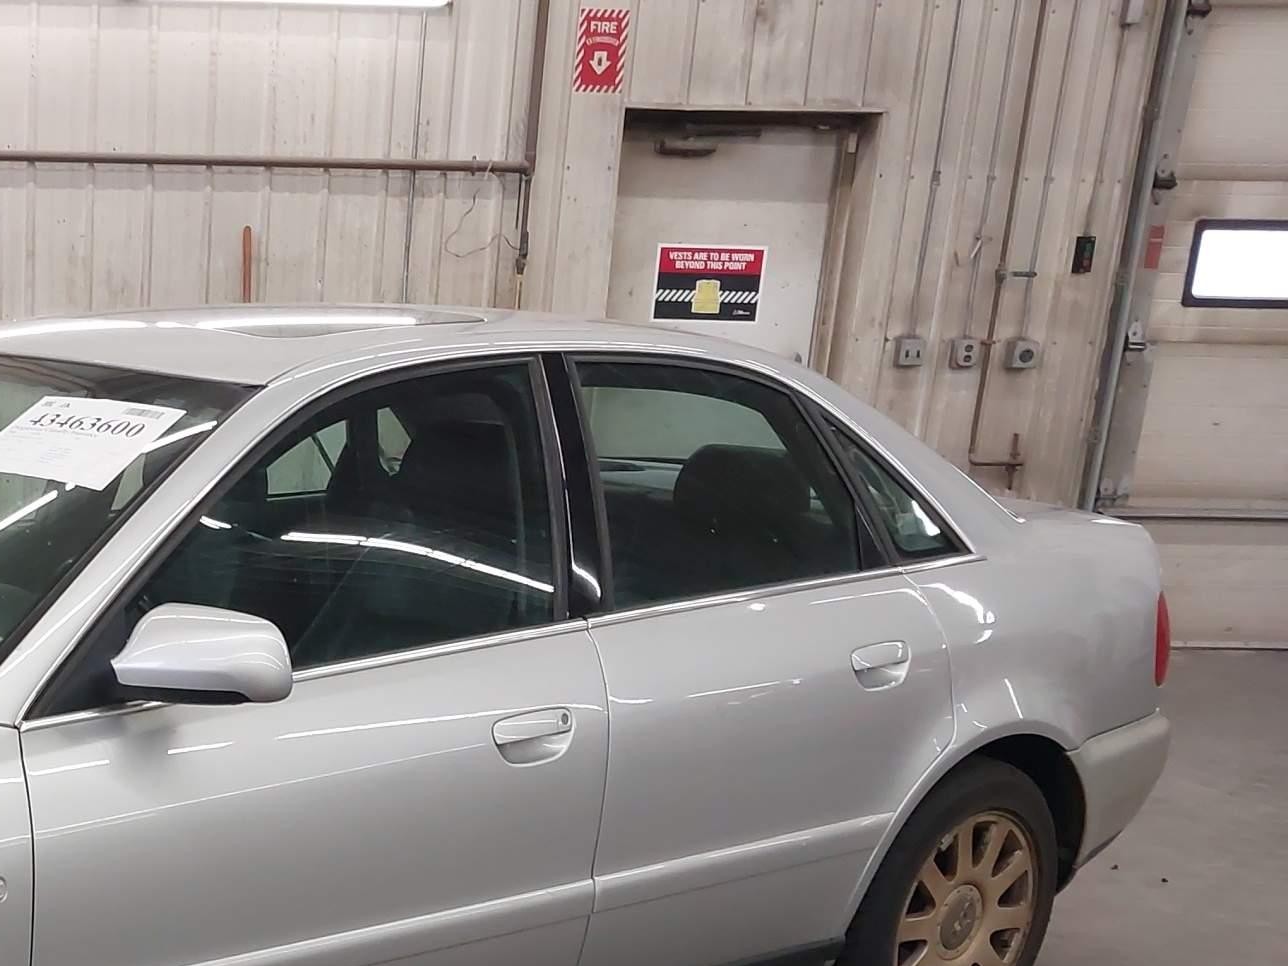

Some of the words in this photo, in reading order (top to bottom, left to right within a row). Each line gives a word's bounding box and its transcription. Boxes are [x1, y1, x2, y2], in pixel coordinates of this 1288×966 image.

[590, 21, 618, 34] FIRE
[669, 251, 693, 261] VESTS
[693, 252, 709, 261] ARE
[710, 252, 720, 261] TO
[720, 252, 731, 261] BE
[731, 253, 755, 262] WORN
[675, 260, 706, 270] BEYOND
[706, 261, 723, 270] THIS
[723, 261, 747, 271] POINT
[29, 413, 146, 438] 43463600
